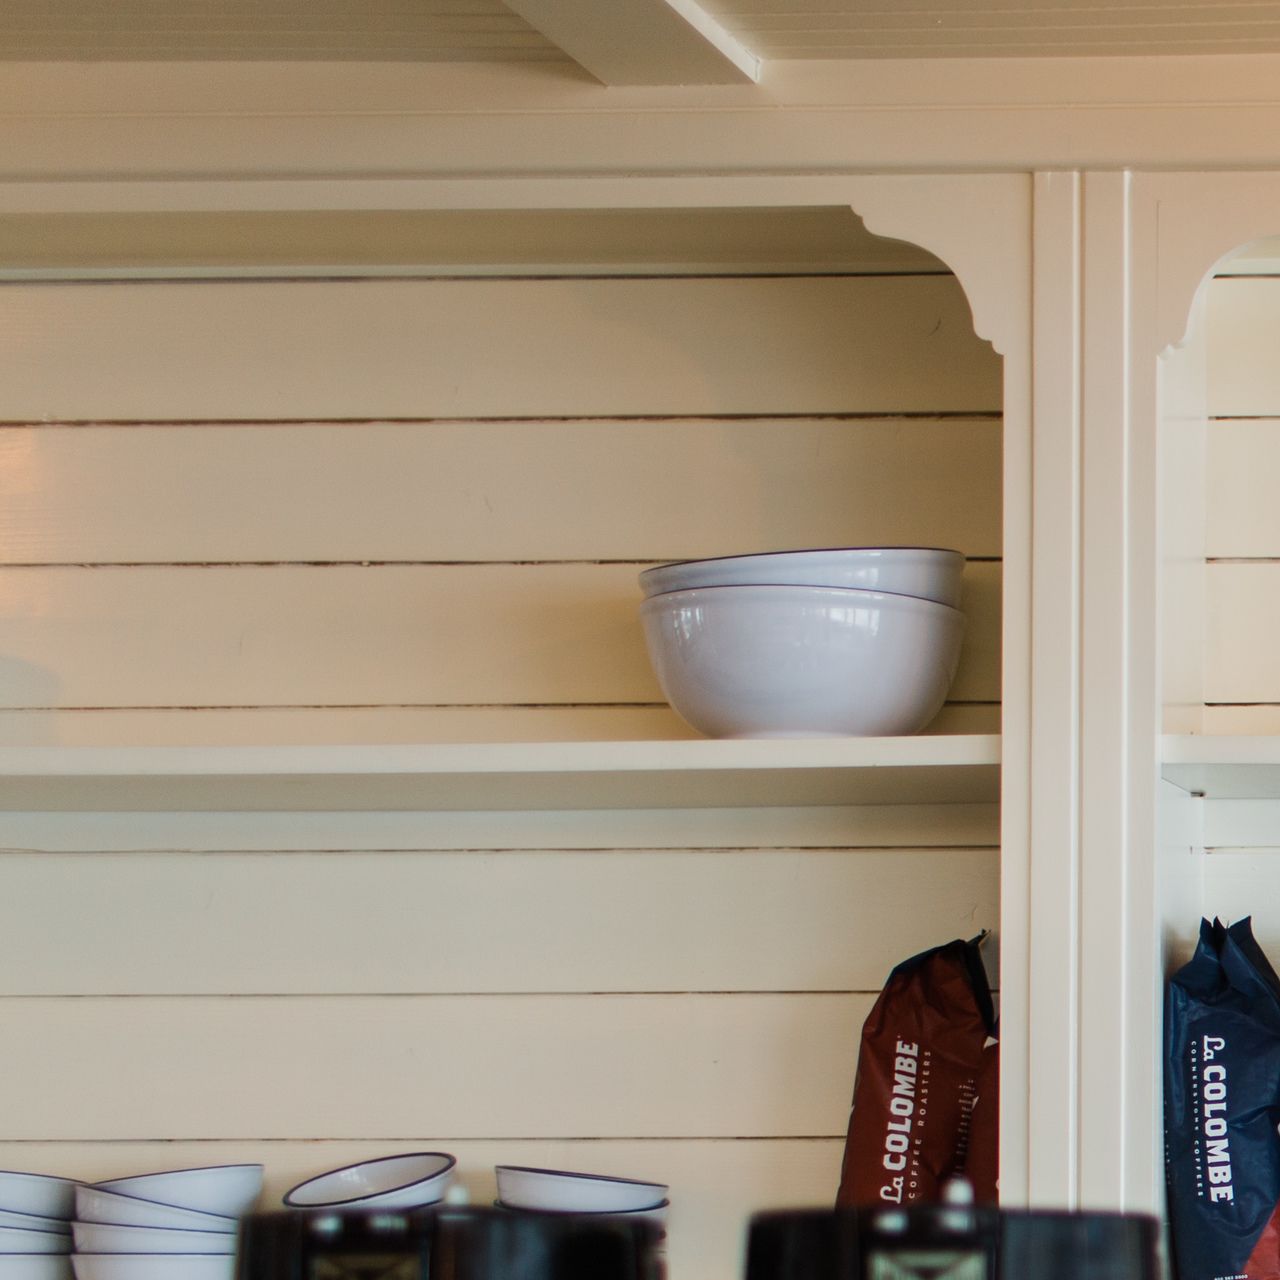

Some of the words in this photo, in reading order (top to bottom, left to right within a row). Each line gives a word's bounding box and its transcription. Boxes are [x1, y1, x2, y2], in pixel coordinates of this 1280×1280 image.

[1191, 1040, 1199, 1131] CORNERSTONE
[1203, 1035, 1226, 1062] La
[882, 1040, 919, 1171] COLOMBE
[908, 1139, 922, 1199] COFFEE
[918, 1051, 931, 1127] ROASTERS
[1203, 1064, 1234, 1203] COLOMBE
[880, 1177, 905, 1204] La
